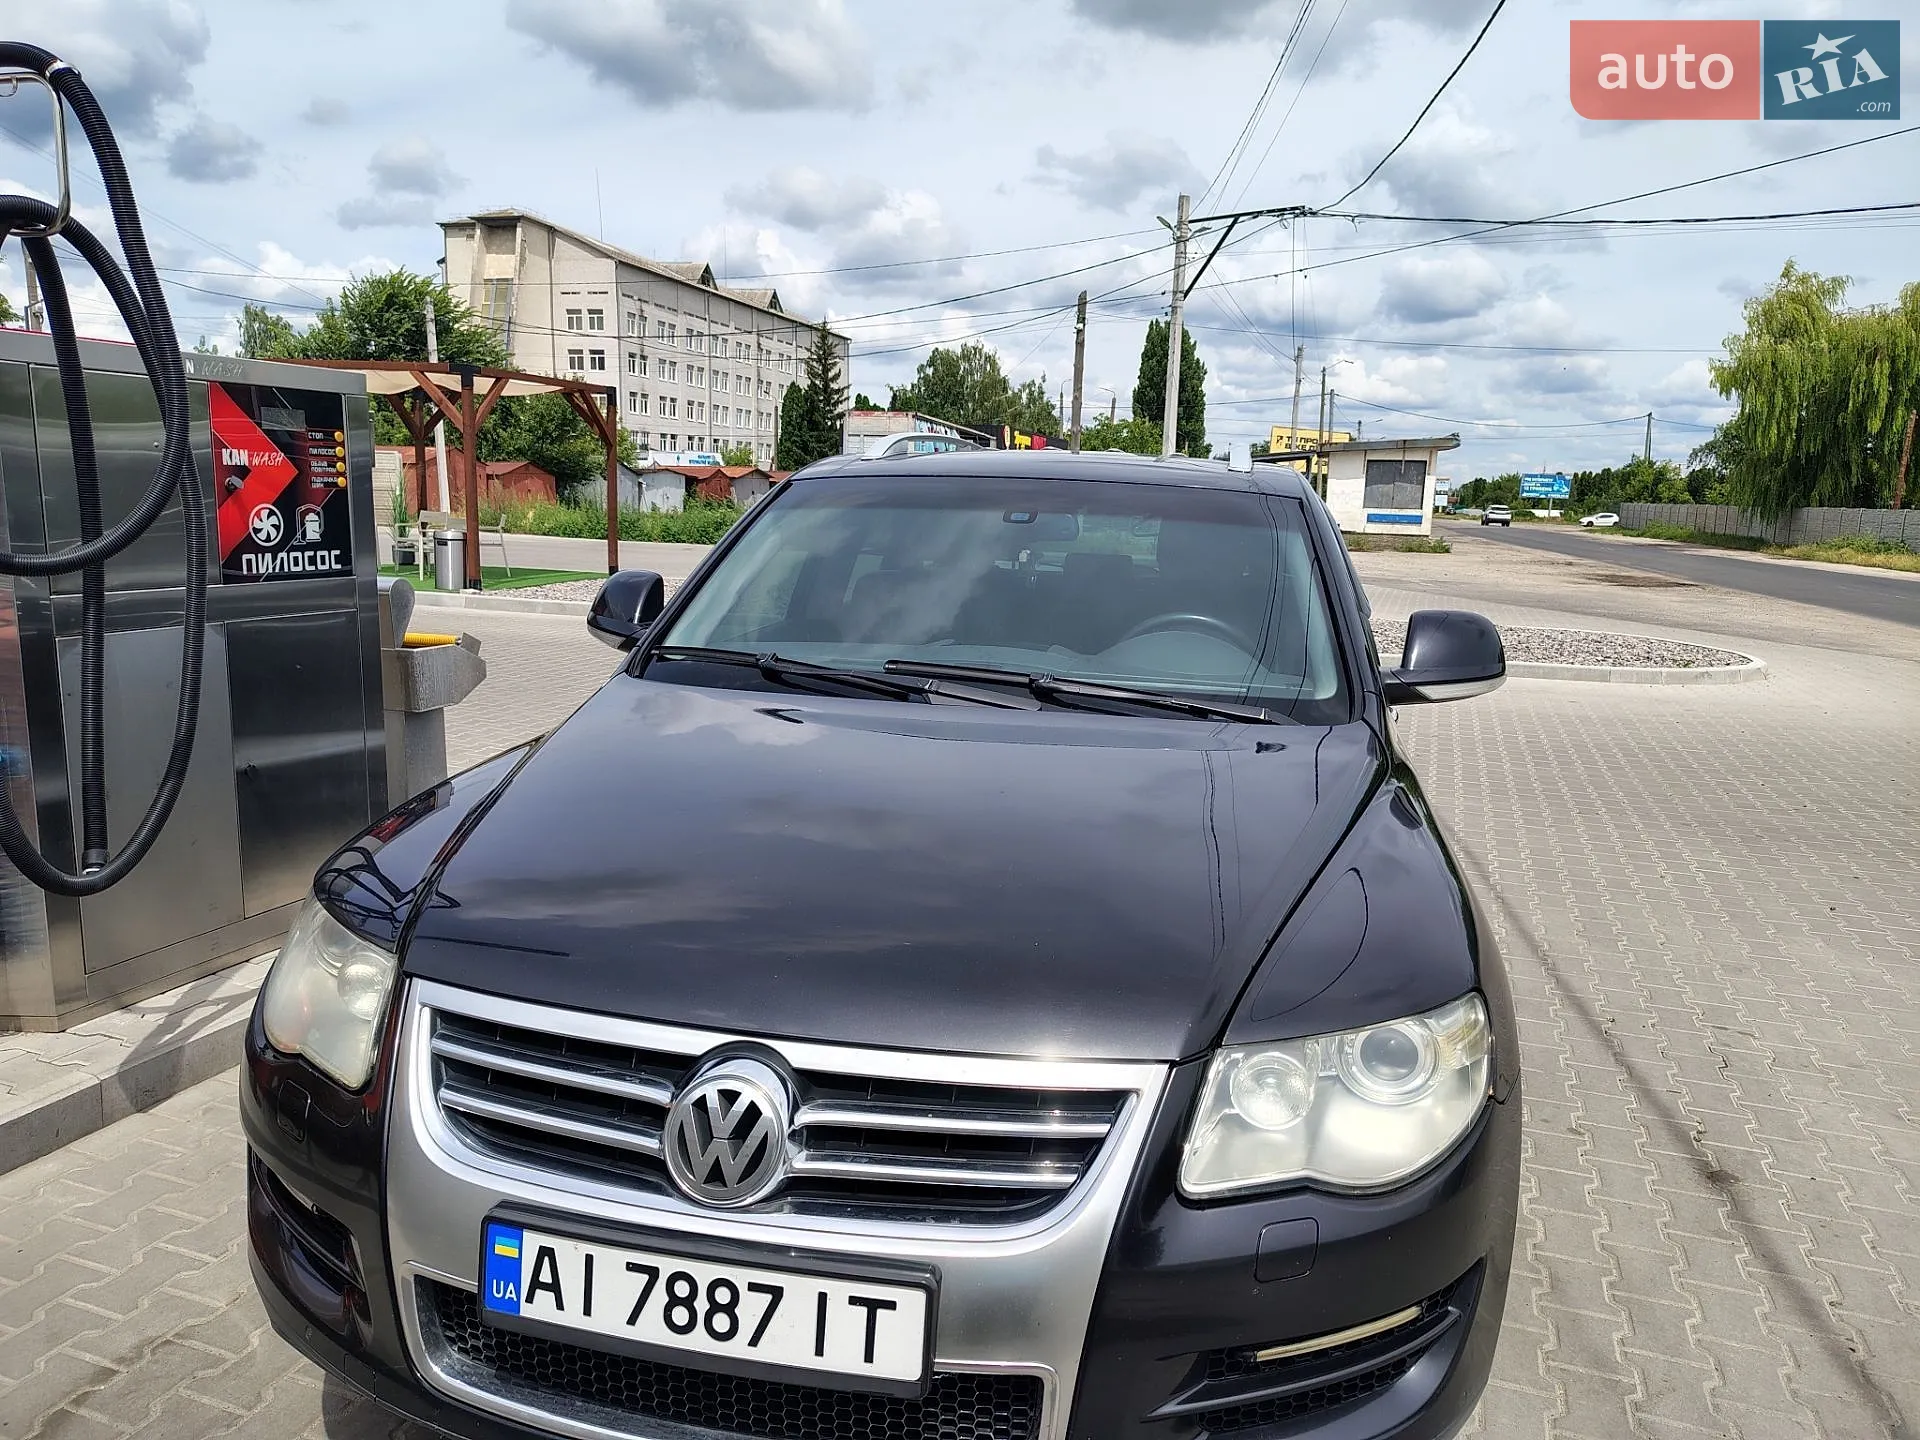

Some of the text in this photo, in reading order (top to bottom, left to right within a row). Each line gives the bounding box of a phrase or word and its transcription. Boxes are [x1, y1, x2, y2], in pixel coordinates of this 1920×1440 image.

[201, 361, 243, 377] WASH
[221, 448, 284, 467] KAN WASH
[308, 448, 336, 456] ПИЛОСОС
[241, 550, 342, 575] ПИЛОСОС
[492, 1279, 518, 1302] UA
[524, 1245, 897, 1364] AI 7887 IT
